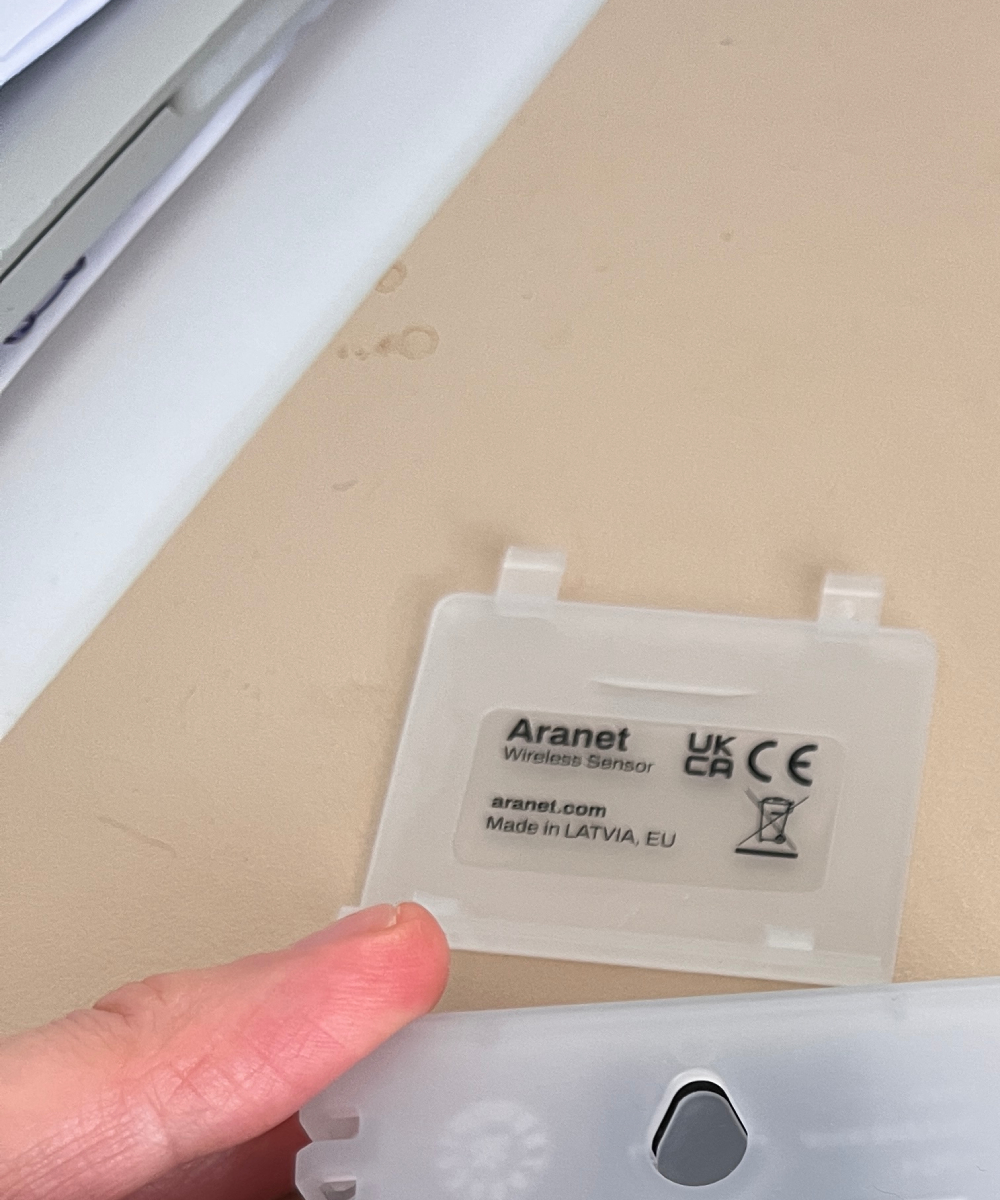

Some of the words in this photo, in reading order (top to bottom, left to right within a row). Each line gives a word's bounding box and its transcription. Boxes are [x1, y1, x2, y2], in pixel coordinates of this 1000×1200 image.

[506, 718, 630, 751] Aranet
[687, 732, 737, 757] UK
[503, 745, 582, 768] Wireless
[586, 754, 656, 774] Sensor
[684, 755, 734, 780] CA
[747, 739, 818, 787] CE
[491, 796, 606, 818] aranet.com
[486, 816, 539, 836] Made
[542, 821, 560, 837] in
[564, 823, 640, 846] LATVIA,
[645, 831, 677, 848] EU
